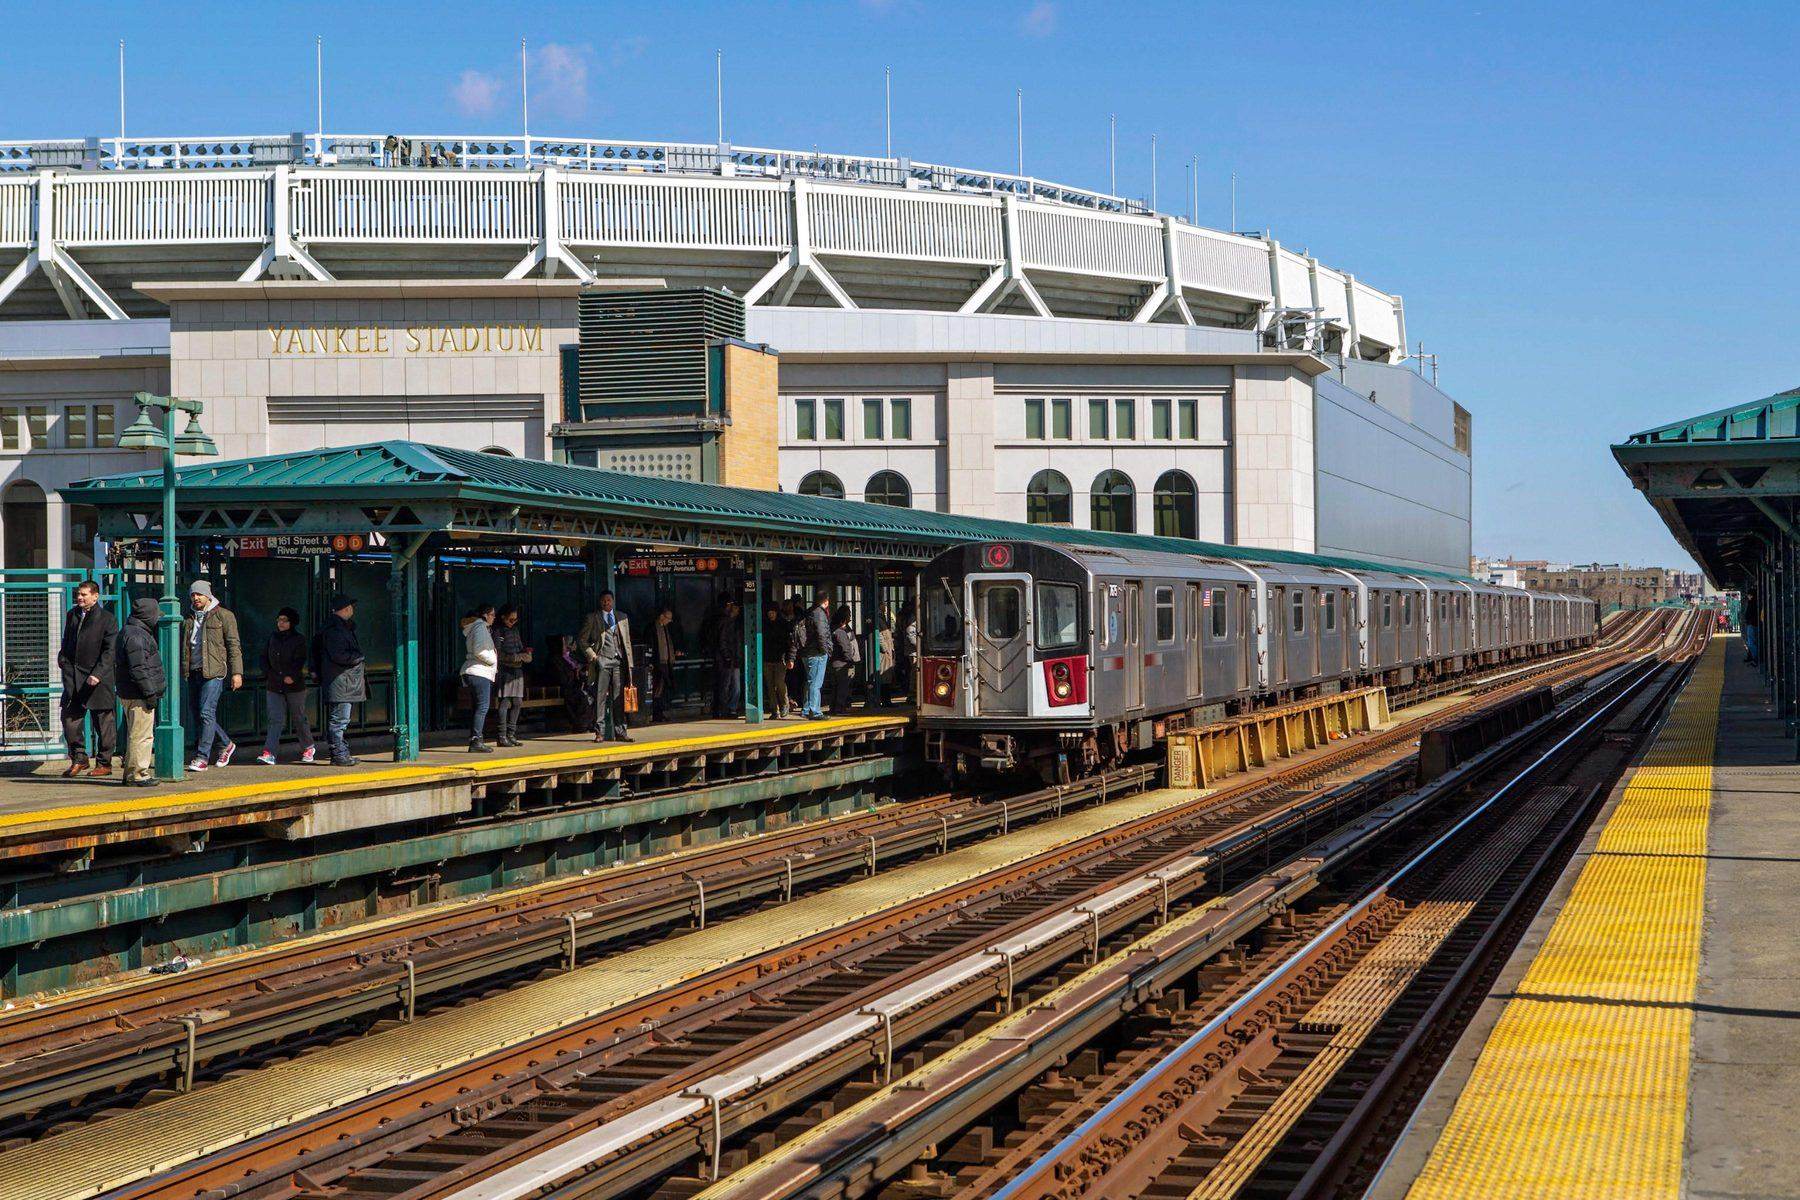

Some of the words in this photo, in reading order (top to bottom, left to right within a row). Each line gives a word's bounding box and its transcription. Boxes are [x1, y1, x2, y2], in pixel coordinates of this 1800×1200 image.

[268, 325, 389, 354] YANKEE
[405, 323, 544, 353] STADIUM
[240, 537, 265, 550] Exit
[278, 536, 291, 545] 161
[293, 536, 319, 545] Street
[322, 536, 329, 545] &
[277, 545, 299, 555] River
[301, 546, 332, 554] Avenue
[628, 560, 648, 569] Exit
[1173, 750, 1181, 781] DANGER
